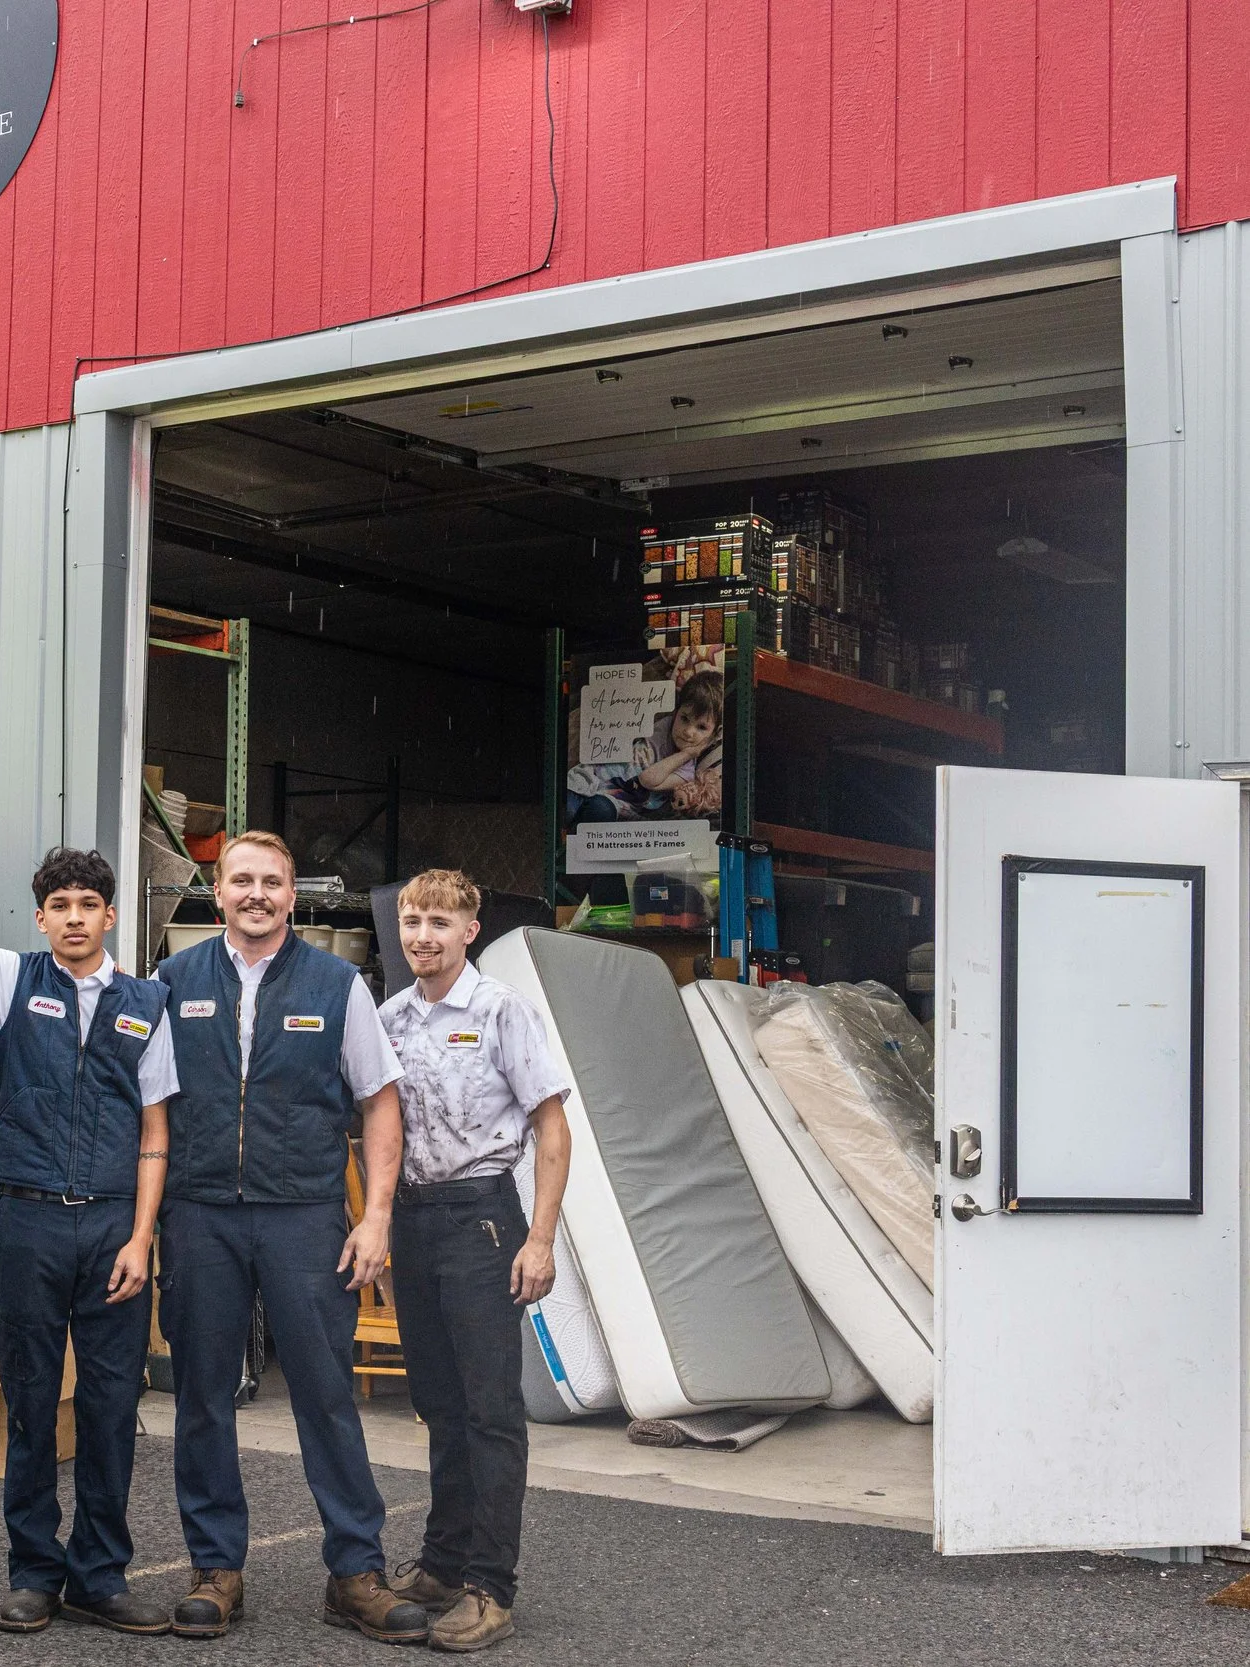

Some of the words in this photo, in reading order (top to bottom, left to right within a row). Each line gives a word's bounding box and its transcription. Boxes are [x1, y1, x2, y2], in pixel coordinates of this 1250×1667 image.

[730, 520, 740, 528] 20
[774, 540, 784, 548] 20
[595, 669, 625, 681] HOPE
[627, 668, 637, 679] IS
[591, 689, 606, 713] A
[610, 689, 645, 716] bouncy
[647, 687, 666, 708] bed
[588, 717, 606, 739] for
[609, 720, 623, 729] me
[626, 713, 645, 733] and
[590, 736, 621, 761] Bella
[586, 831, 603, 839] This
[605, 830, 632, 839] Month
[634, 830, 655, 838] We'll
[657, 829, 679, 838] Need
[597, 841, 643, 849] Mattresses
[653, 840, 686, 848] Frames
[34, 1000, 62, 1013] Anthony
